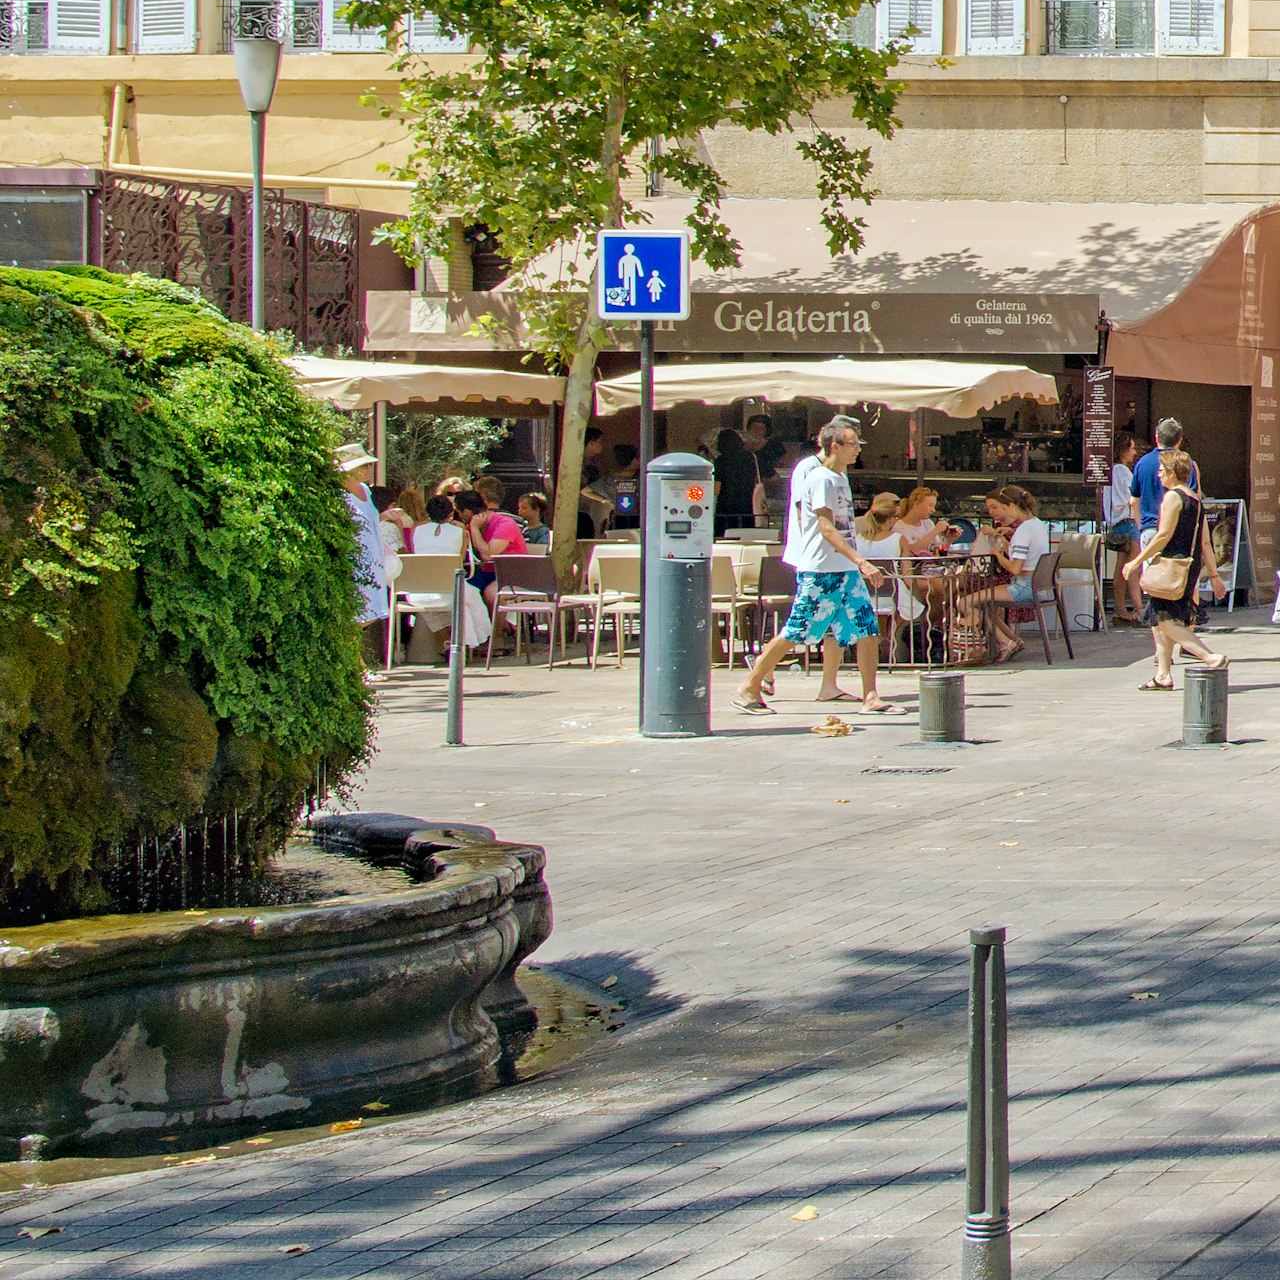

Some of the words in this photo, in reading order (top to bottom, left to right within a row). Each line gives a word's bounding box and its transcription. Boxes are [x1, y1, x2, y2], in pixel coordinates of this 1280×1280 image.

[976, 299, 1027, 311] Gelateria
[950, 313, 961, 324] di
[964, 313, 1002, 327] qualita
[1025, 313, 1053, 324] 1962
